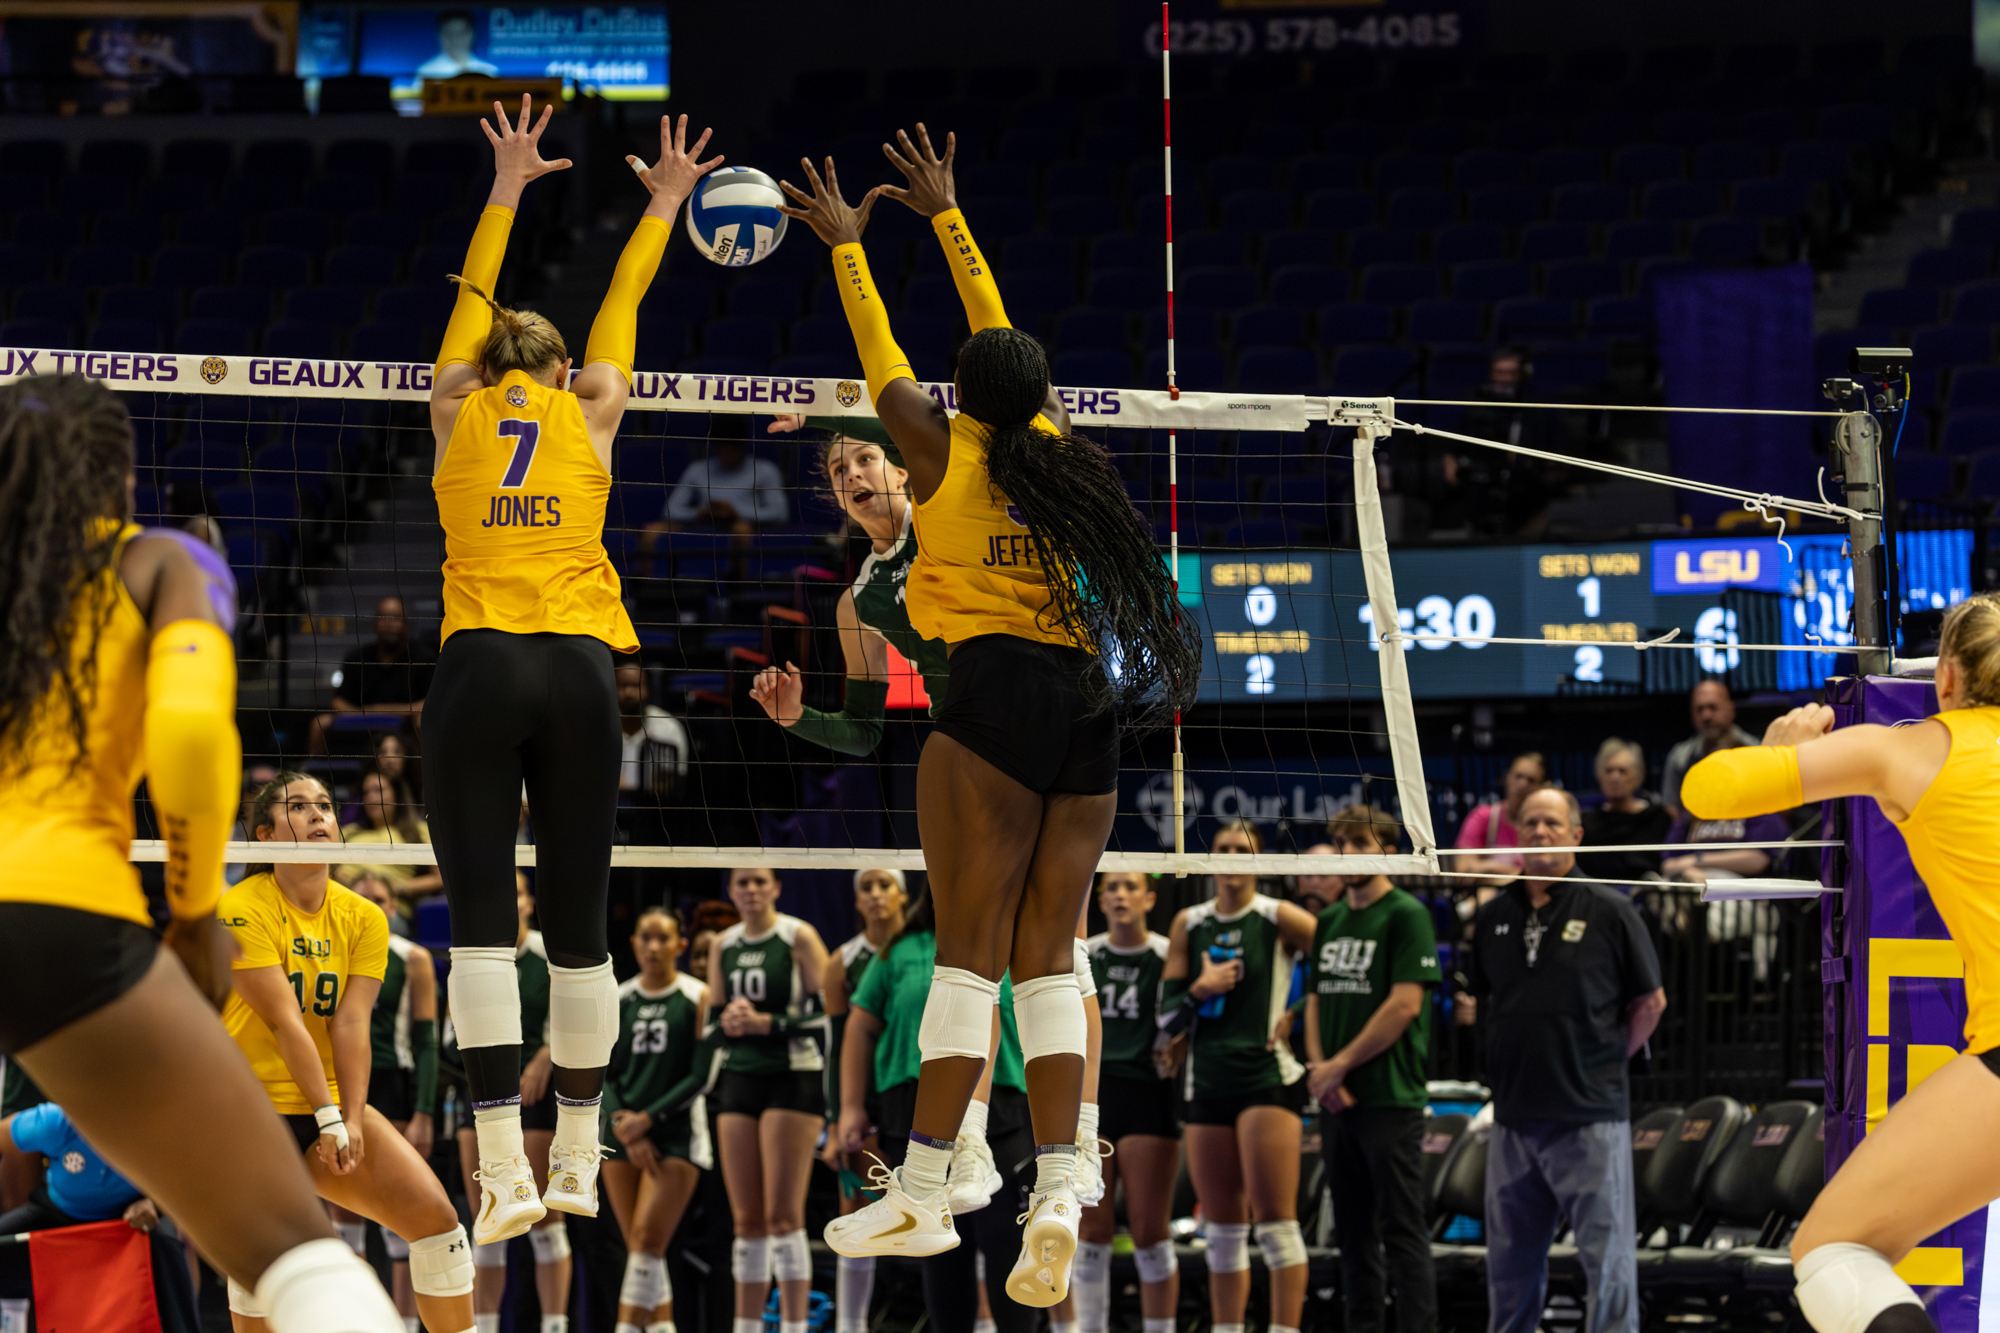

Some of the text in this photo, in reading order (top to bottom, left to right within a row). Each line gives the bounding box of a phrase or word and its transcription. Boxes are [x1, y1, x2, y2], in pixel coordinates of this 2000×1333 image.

[50, 351, 178, 382] TIGERS
[249, 358, 433, 391] GEAUX TIG
[693, 375, 816, 405] TIGERS
[1057, 388, 1121, 415] ERS
[1349, 401, 1378, 410] Senoh
[496, 417, 541, 489] 7
[481, 495, 561, 528] JONES
[982, 534, 1040, 567] JEFF
[1675, 549, 1761, 584] LSU
[1244, 585, 1278, 626] 0
[1576, 577, 1601, 618] 1
[1245, 653, 1276, 694] 2
[1573, 645, 1604, 682] 2
[1292, 782, 1364, 824] Lad
[729, 967, 767, 1001] 10
[1101, 983, 1140, 1019] 14
[632, 1020, 669, 1054] 23
